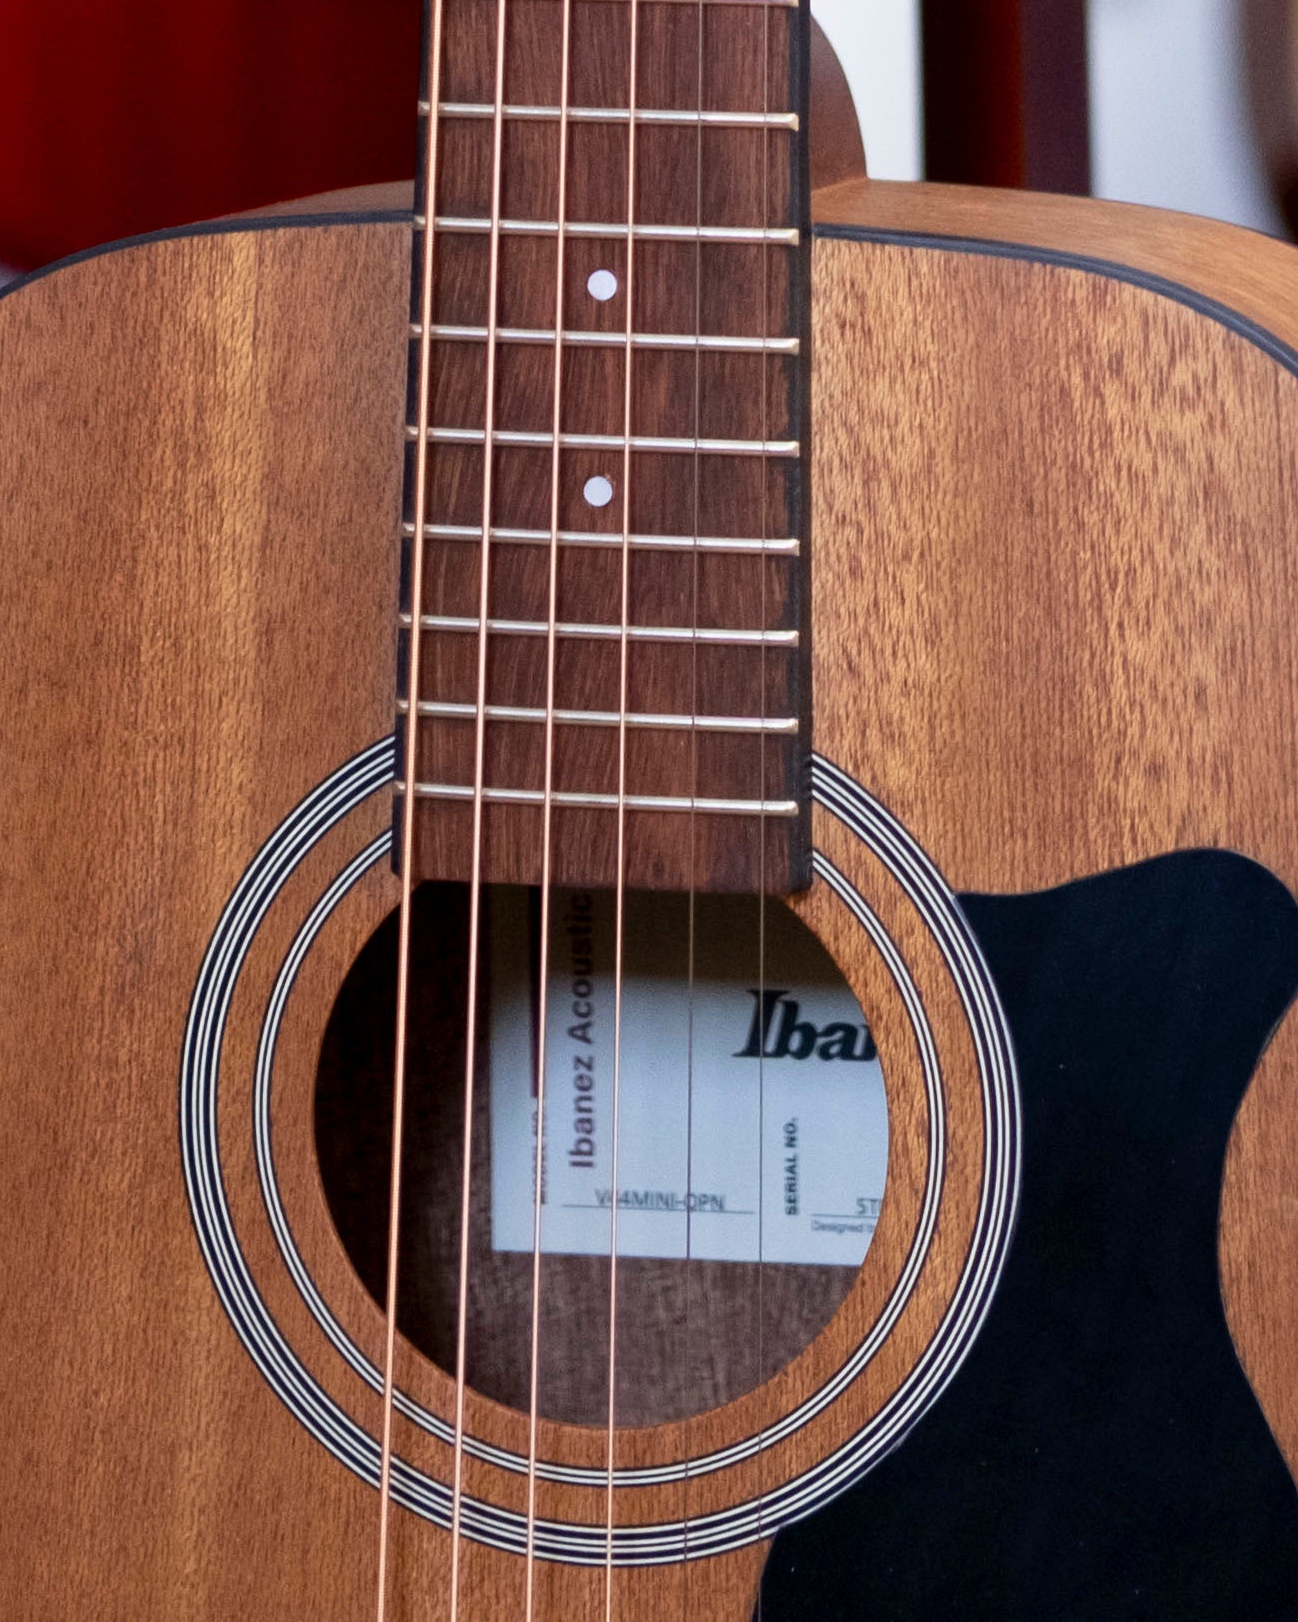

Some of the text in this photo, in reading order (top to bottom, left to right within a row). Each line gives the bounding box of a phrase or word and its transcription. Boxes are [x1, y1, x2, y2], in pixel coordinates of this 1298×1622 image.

[567, 893, 595, 1168] Ibanez Acoustic
[594, 1188, 725, 1211] V4MINI-OPN
[784, 1154, 798, 1216] SERIAL
